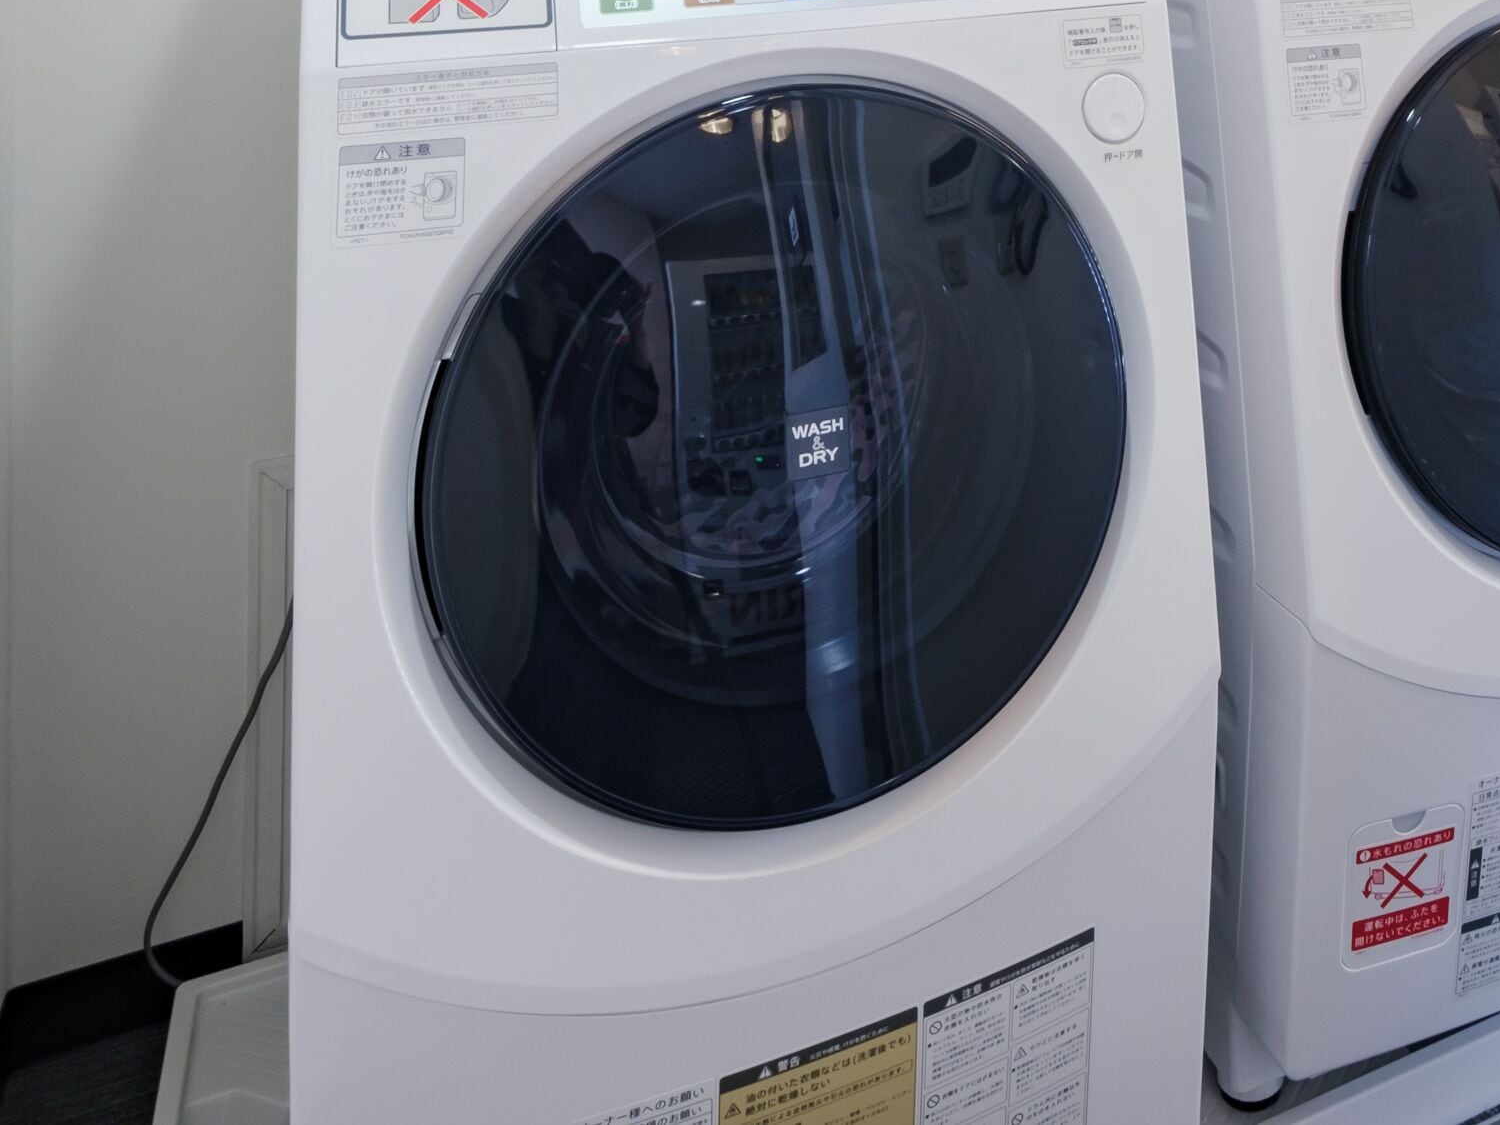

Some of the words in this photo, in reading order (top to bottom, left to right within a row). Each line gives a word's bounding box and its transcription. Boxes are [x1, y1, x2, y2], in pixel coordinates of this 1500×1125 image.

[399, 143, 432, 158] 注意
[346, 166, 408, 178] けがの恐れあり
[791, 417, 844, 440] WASH
[812, 435, 825, 450] &
[798, 446, 839, 468] DRY
[1373, 832, 1452, 858] 水もれの恐れあり
[1354, 916, 1446, 946] 開けないでください。
[962, 983, 983, 999] 注意
[777, 1056, 800, 1072] 警告
[745, 1078, 830, 1117] 絶対に乾燥しない
